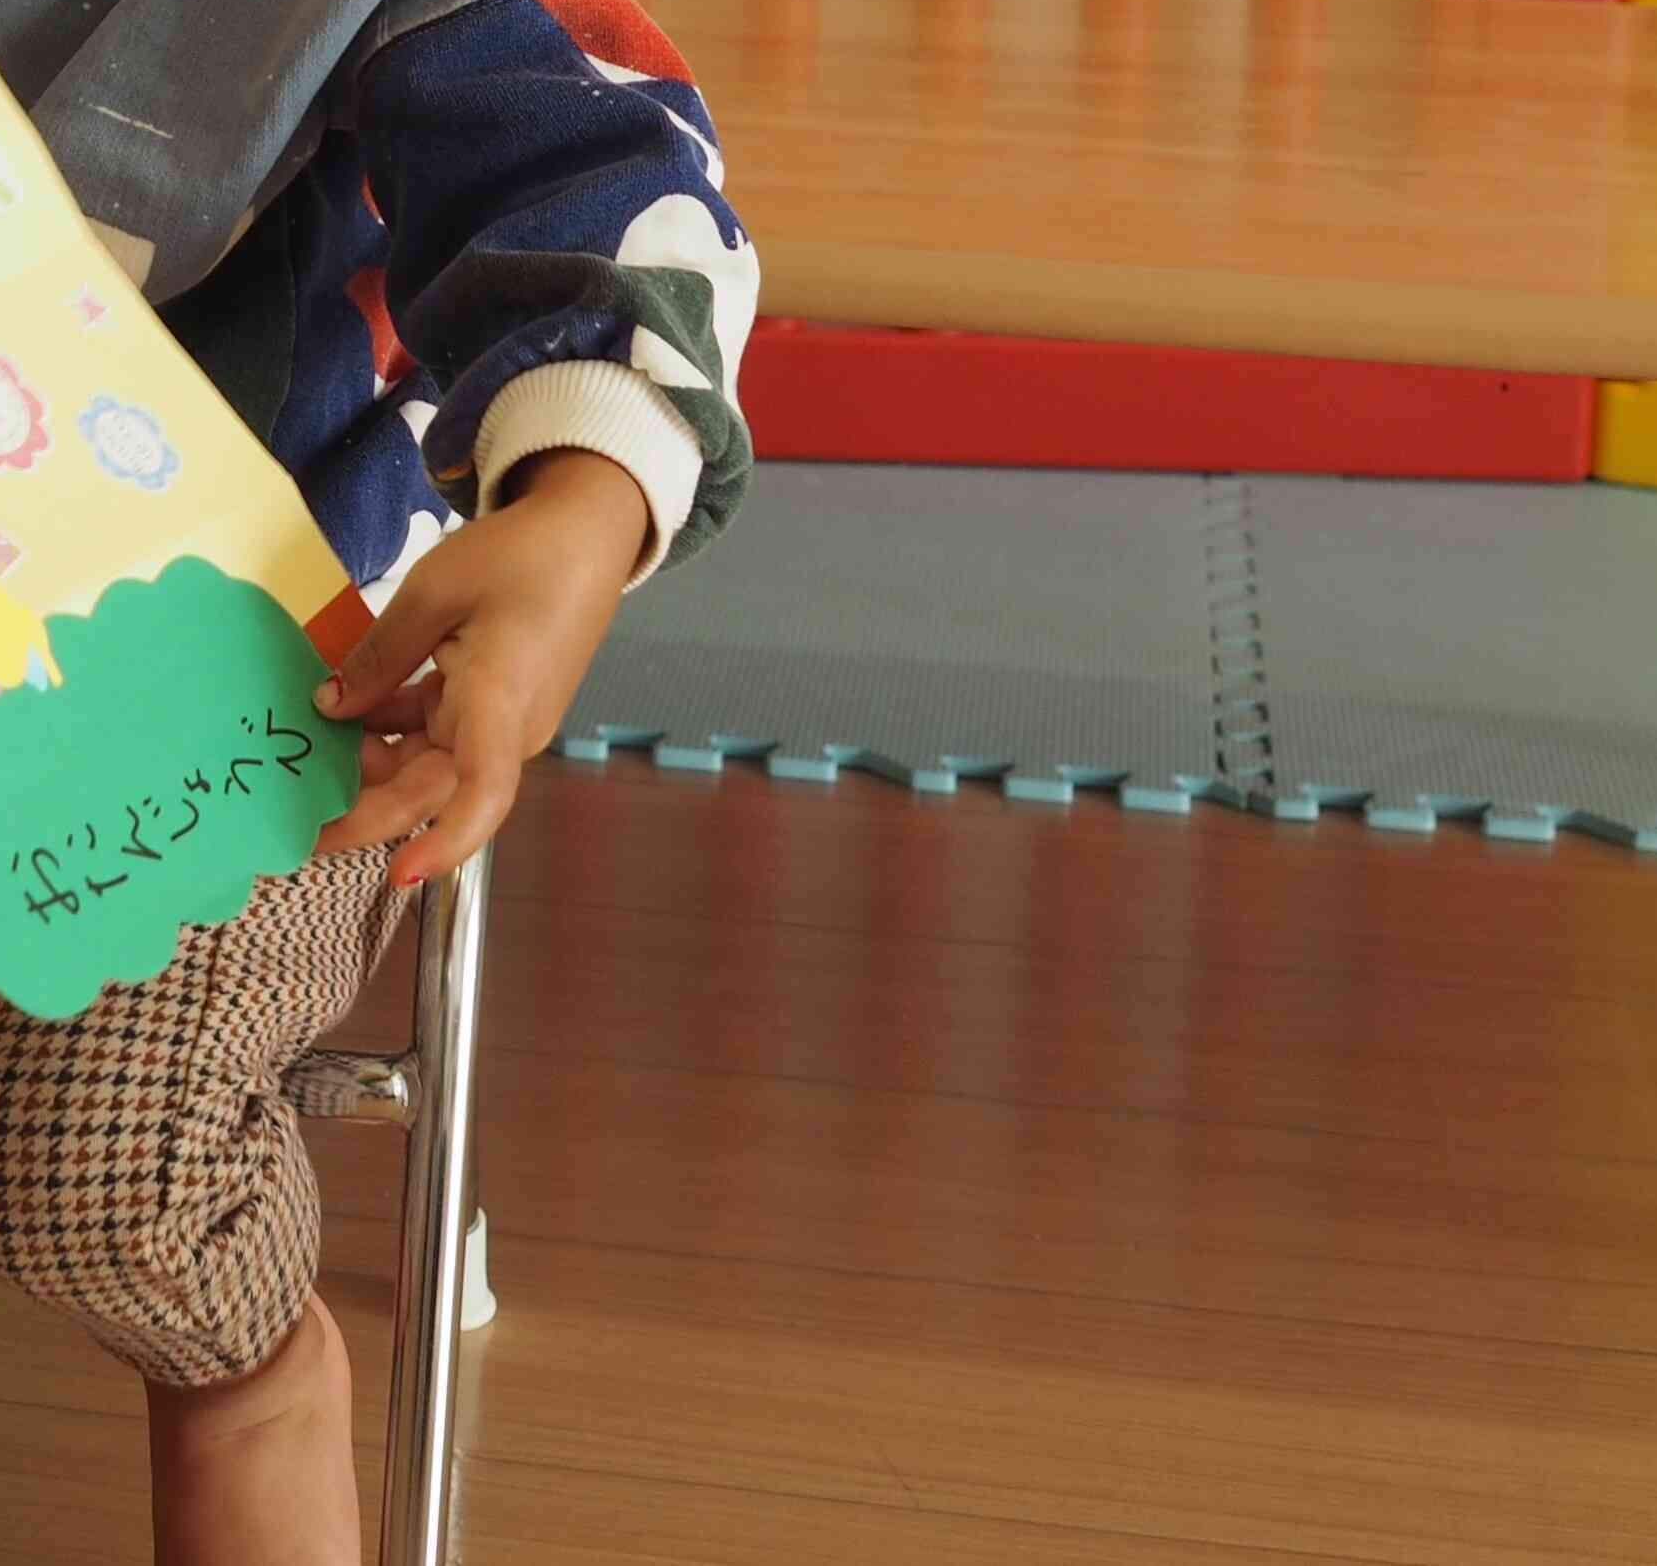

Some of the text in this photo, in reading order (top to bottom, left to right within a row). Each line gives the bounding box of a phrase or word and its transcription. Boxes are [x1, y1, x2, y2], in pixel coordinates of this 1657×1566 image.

[12, 708, 313, 925] おたんじょうび
